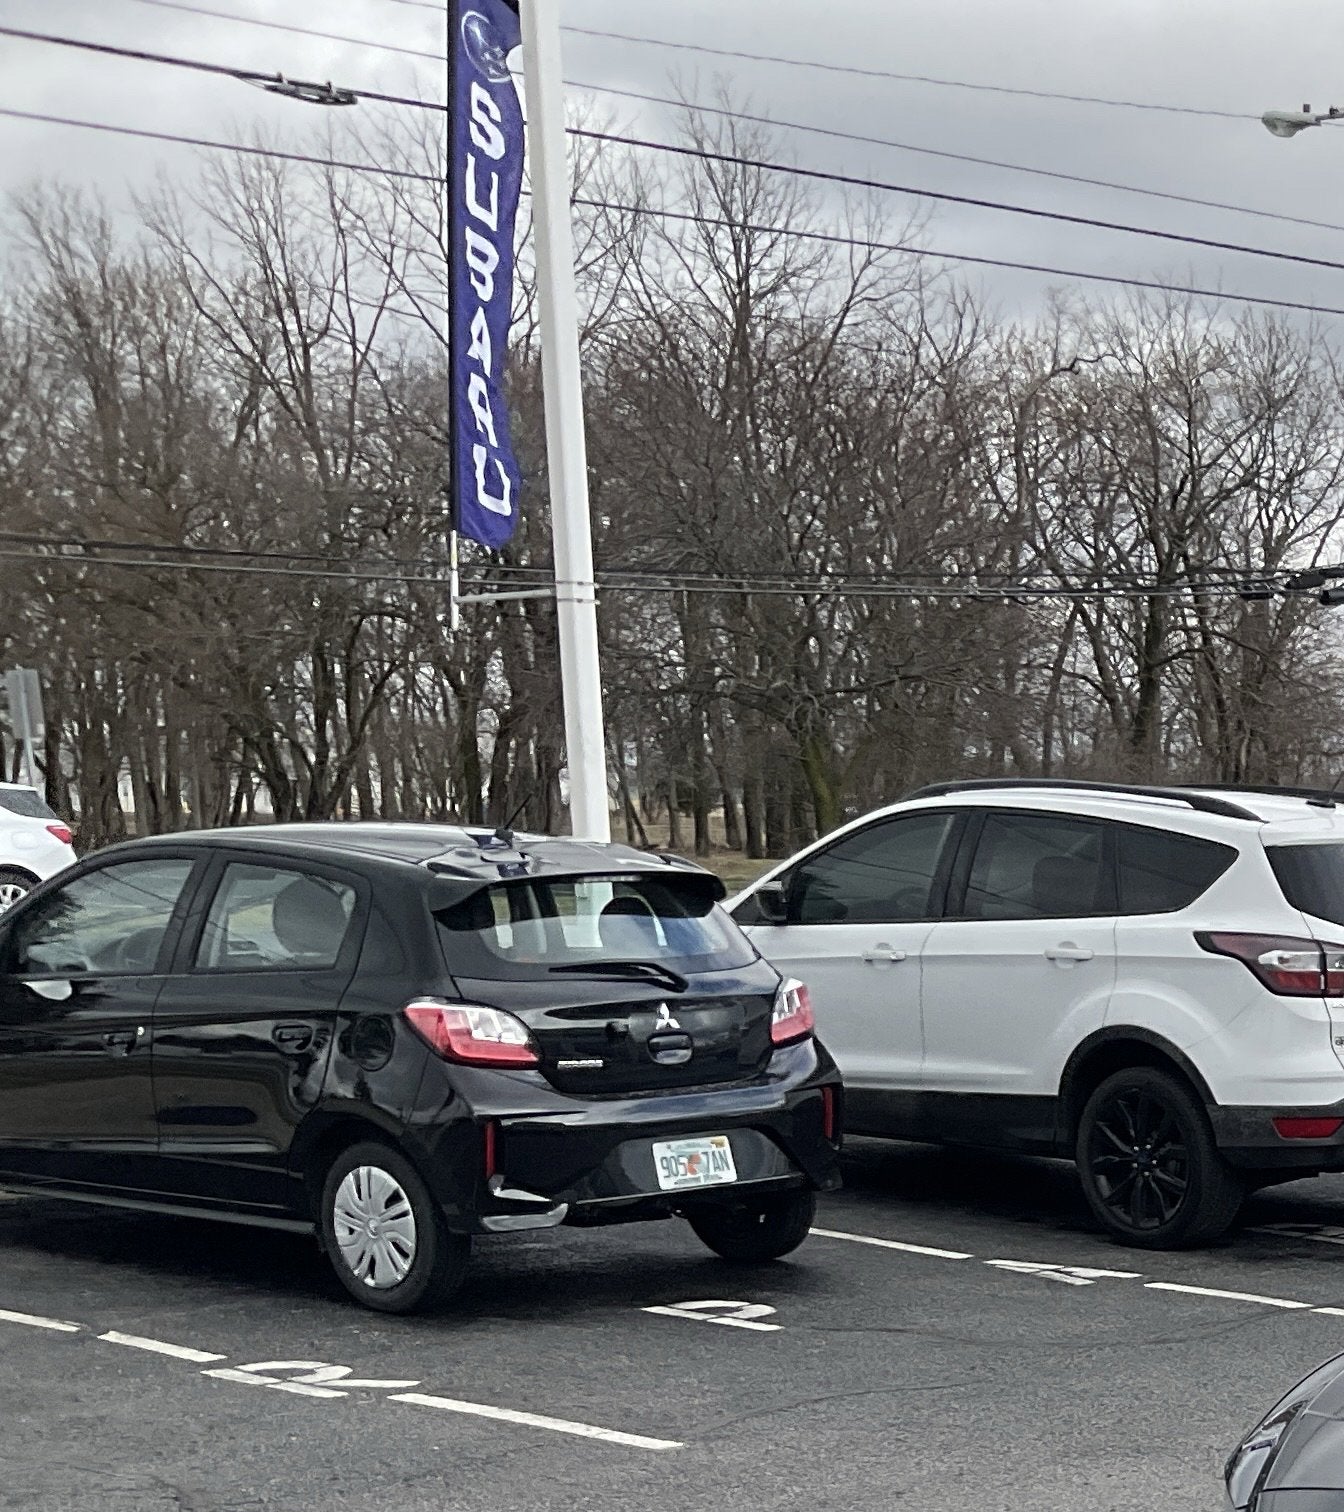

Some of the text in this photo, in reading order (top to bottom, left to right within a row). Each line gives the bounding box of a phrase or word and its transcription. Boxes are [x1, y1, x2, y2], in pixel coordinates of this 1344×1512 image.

[465, 81, 511, 517] SUBARU
[660, 1149, 731, 1178] 905 7AN
